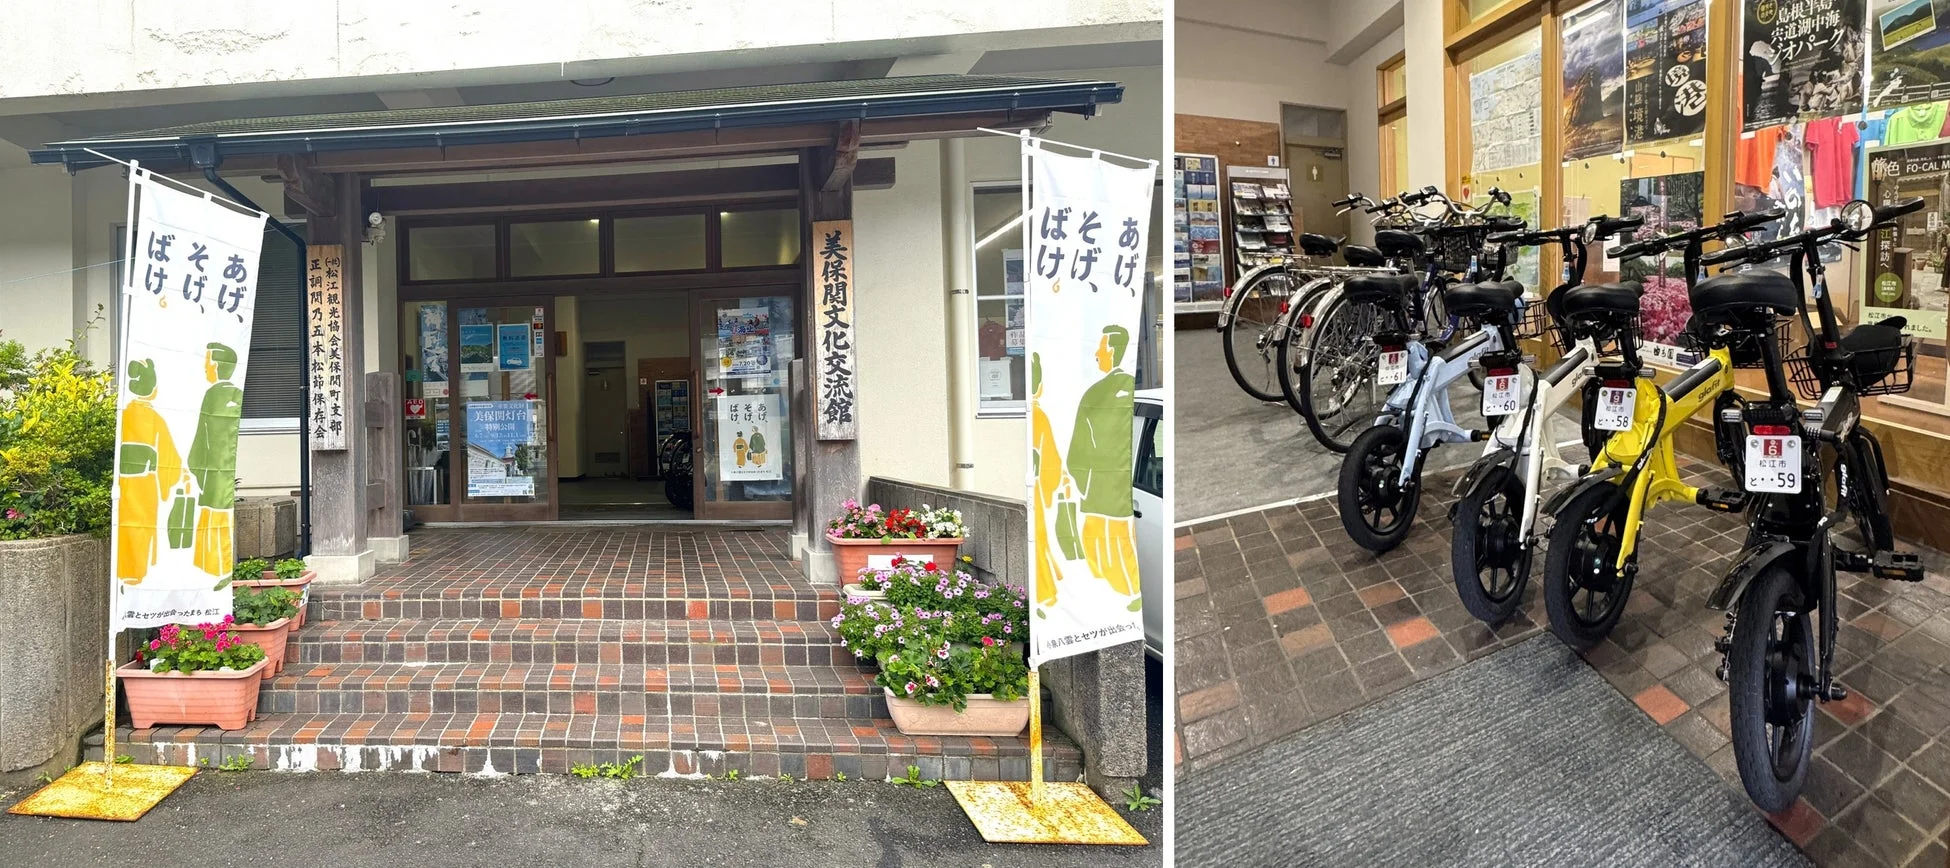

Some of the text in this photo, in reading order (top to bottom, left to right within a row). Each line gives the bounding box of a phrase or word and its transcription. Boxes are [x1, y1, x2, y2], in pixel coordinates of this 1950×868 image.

[1770, 9, 1840, 45] 宍道湖中海
[1769, 29, 1845, 66] ジオパーク
[1906, 161, 1939, 173] FO-CAL
[1071, 211, 1102, 293] そげ、
[1114, 216, 1139, 298] あげ、
[183, 242, 208, 314] そげ、
[218, 254, 247, 323] あげ、
[820, 230, 854, 425] 美保関文化交流館
[1698, 378, 1721, 403] glafit
[474, 410, 527, 422] 美保関灯台
[744, 403, 754, 423] そげ、
[758, 404, 768, 423] あげ、
[1760, 460, 1787, 468] 松江市
[122, 608, 220, 620] 雲とセツが出会ったまち 松江
